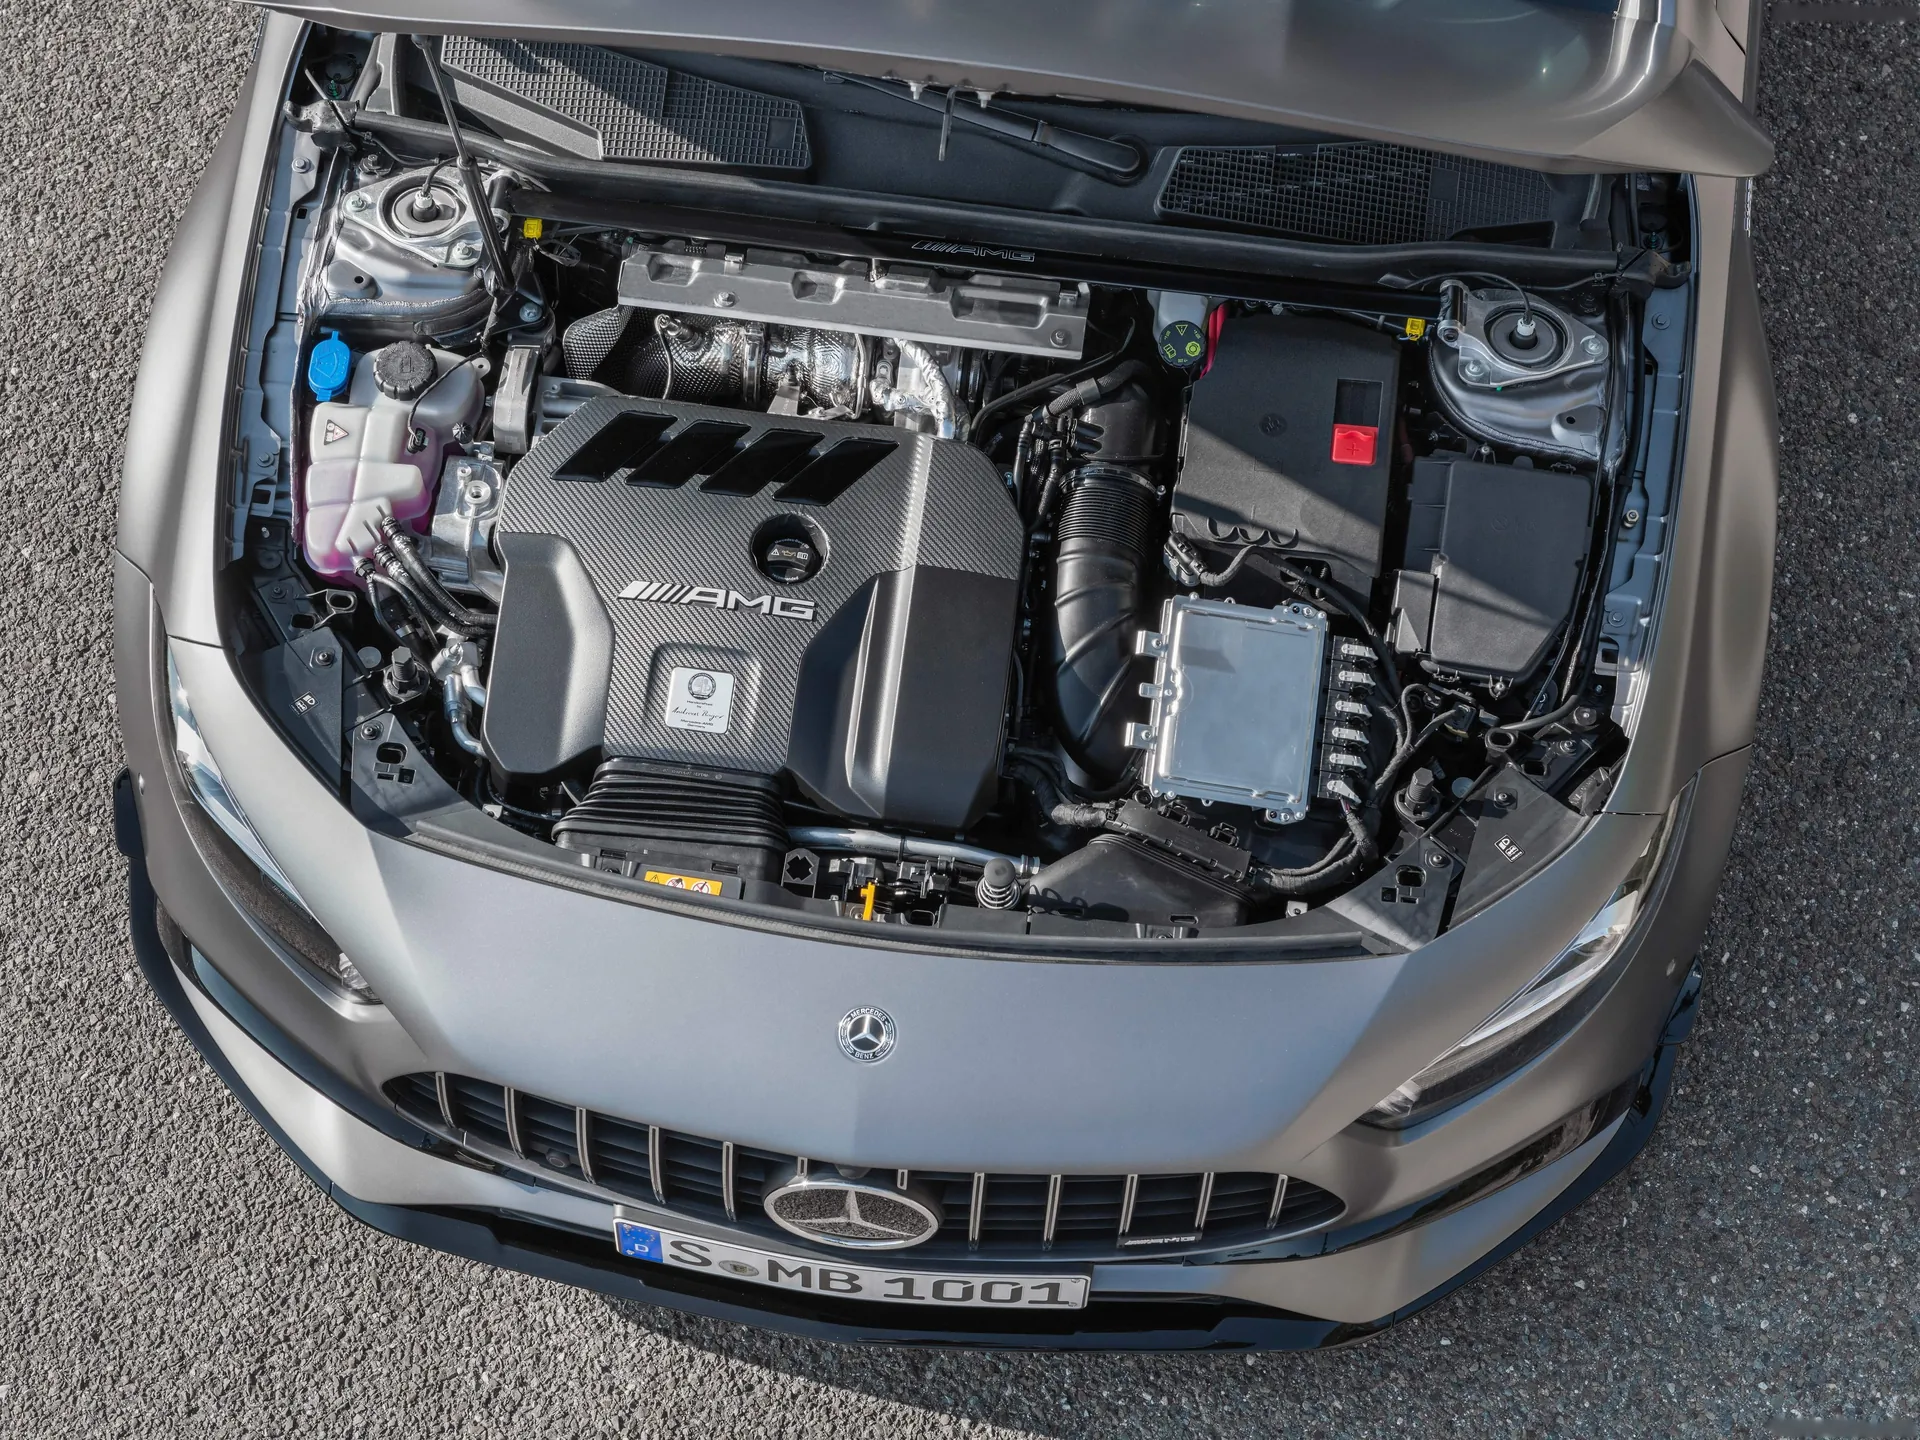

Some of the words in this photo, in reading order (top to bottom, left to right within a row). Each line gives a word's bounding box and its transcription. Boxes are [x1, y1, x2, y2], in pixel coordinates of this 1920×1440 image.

[850, 1008, 886, 1022] MERCEDES
[854, 1052, 875, 1060] BENZ
[634, 1243, 649, 1253] D
[668, 1240, 713, 1267] S
[767, 1259, 863, 1294] MB
[883, 1277, 1070, 1305] 1001
